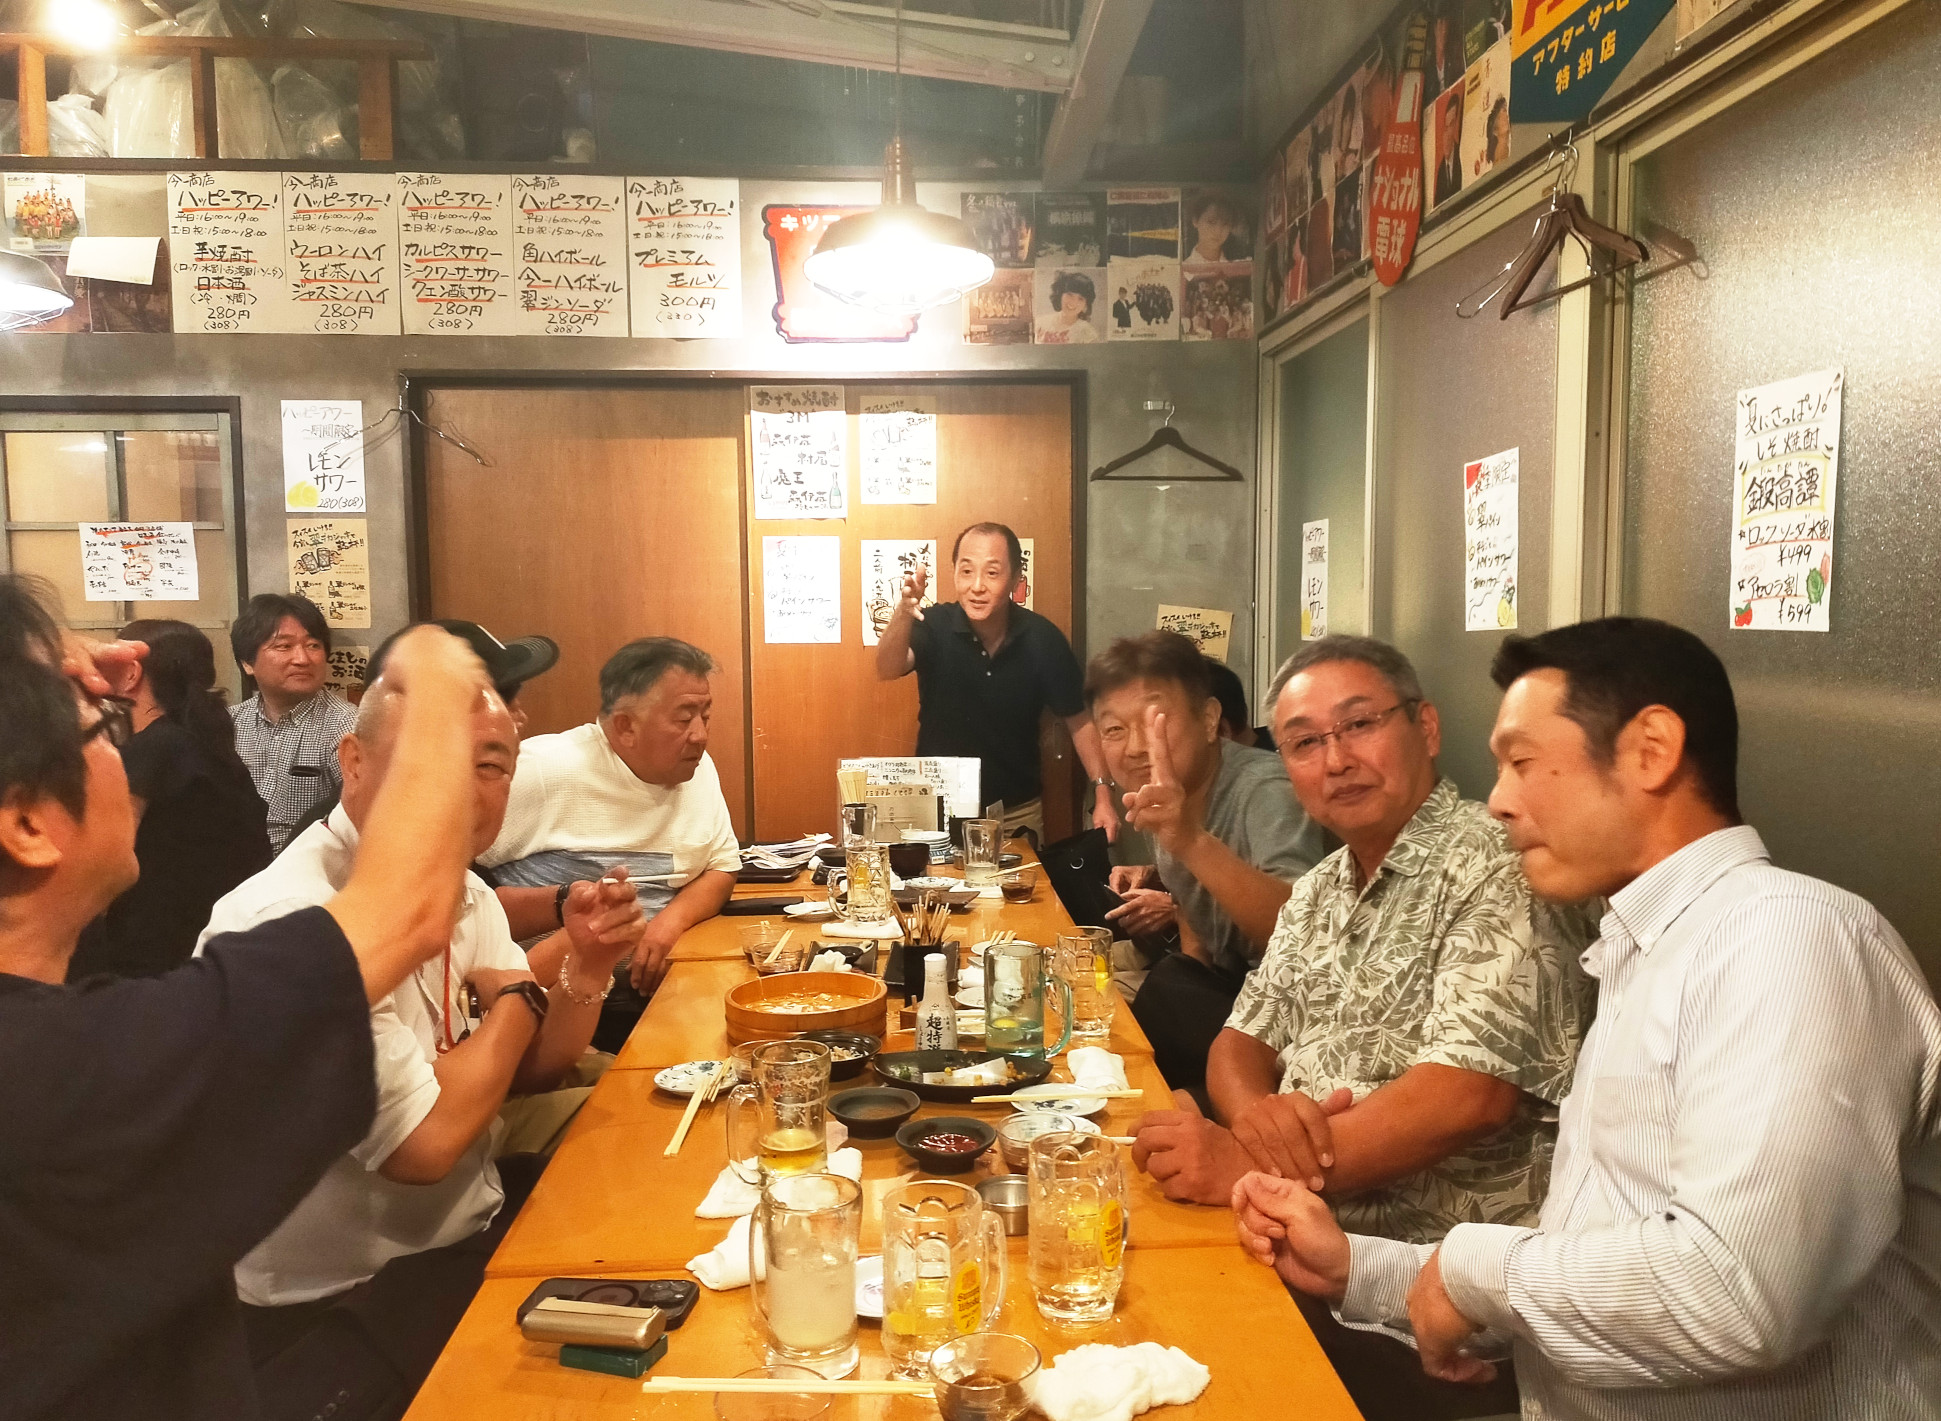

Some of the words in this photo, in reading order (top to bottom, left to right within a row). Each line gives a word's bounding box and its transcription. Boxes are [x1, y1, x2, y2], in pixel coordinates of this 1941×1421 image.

[1556, 29, 1617, 95] 特約店
[1372, 164, 1419, 213] ナショナル
[194, 241, 254, 263] 芋焼酎
[290, 239, 386, 262] ウーロンハイ
[404, 242, 503, 258] カルピスサワー
[1375, 215, 1407, 268] 電球
[522, 242, 607, 267] 角ハイボール
[635, 248, 711, 266] プレミアム
[299, 261, 385, 283] そば茶ハイ
[669, 272, 726, 289] モルツ
[197, 276, 245, 291] 日本酒
[291, 283, 389, 304] ジャスミンハイ
[320, 303, 373, 320] 280円
[433, 302, 483, 317] 280円
[520, 290, 613, 313] 翠ジンソーダ
[660, 293, 716, 310] 300円
[207, 306, 250, 320] 280円
[547, 313, 599, 326] 280円
[1757, 428, 1819, 460] しそ焼酎
[308, 453, 351, 472] レモン
[314, 473, 357, 492] サワー
[1744, 467, 1819, 514] 鍛高譚
[1777, 544, 1812, 567] ¥499
[1779, 598, 1812, 624] ¥599
